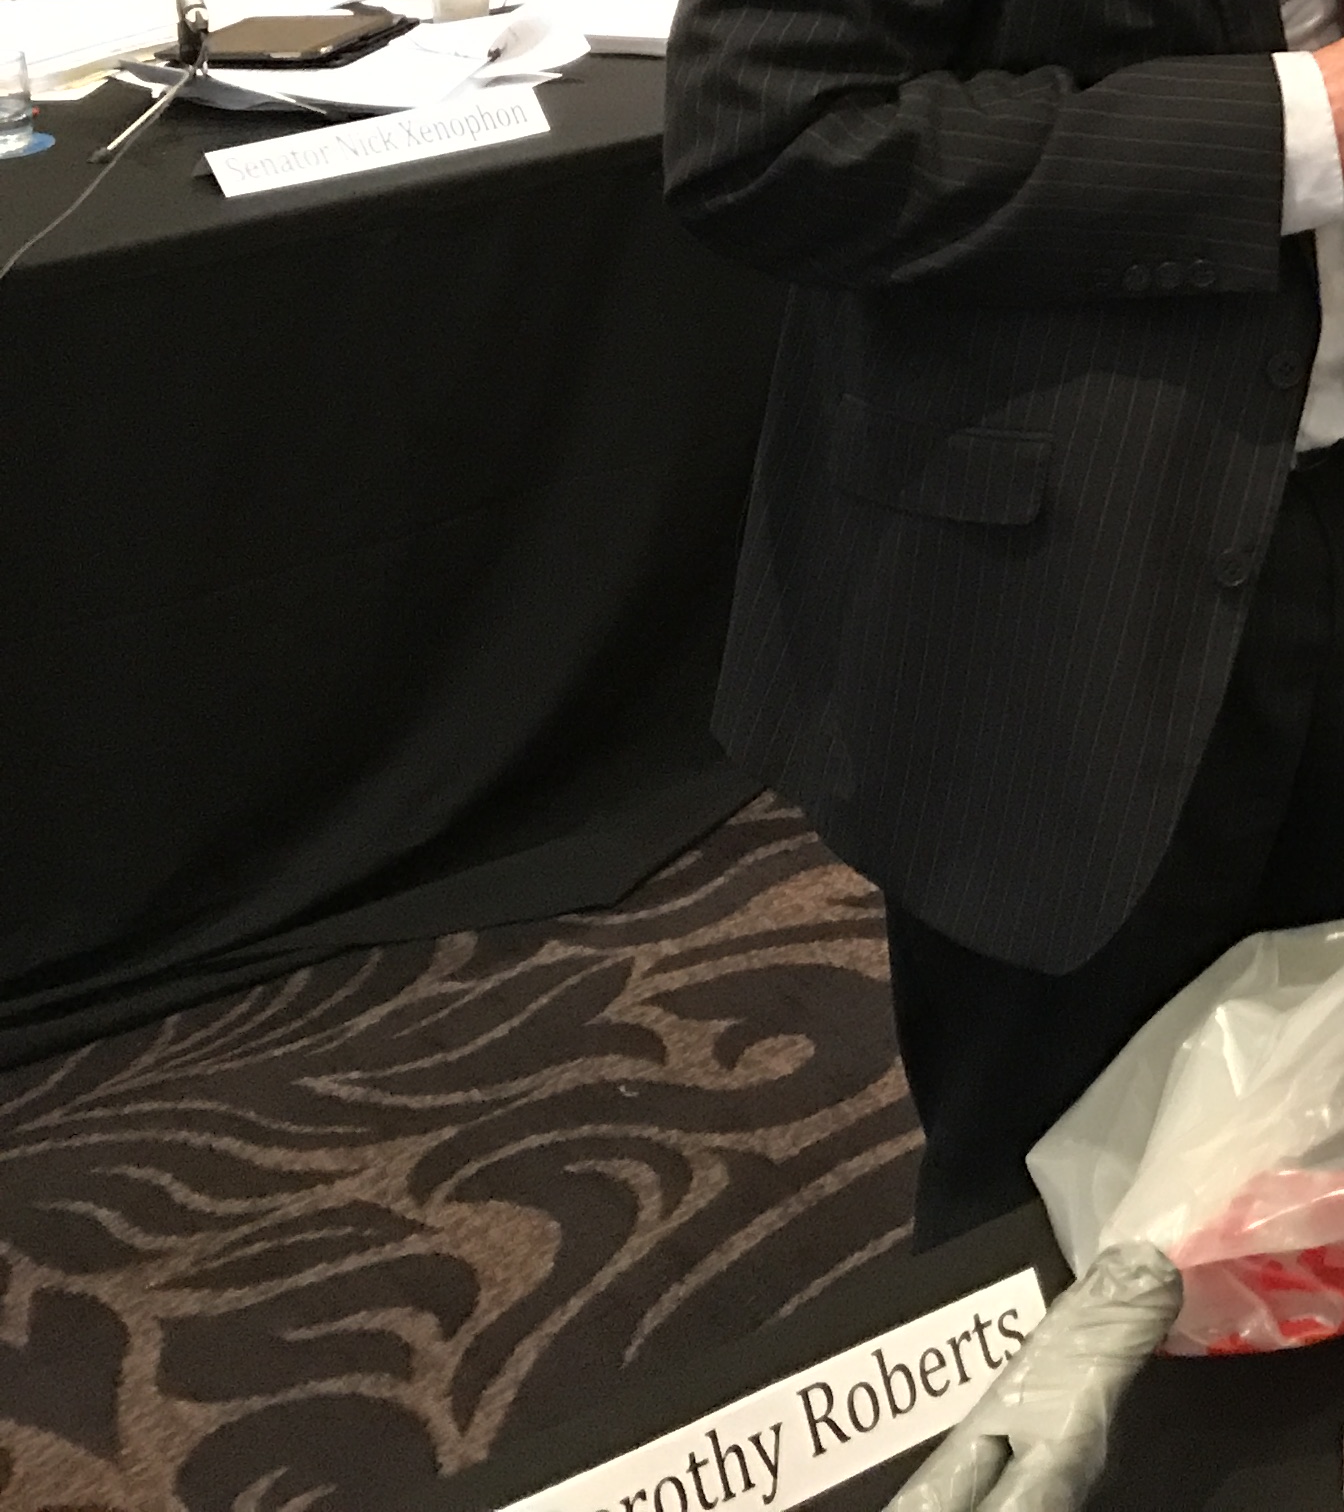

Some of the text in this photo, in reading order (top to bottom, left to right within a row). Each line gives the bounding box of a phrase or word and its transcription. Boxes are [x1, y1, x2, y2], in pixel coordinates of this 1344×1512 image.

[225, 104, 528, 182] Senator Nick Xenophon
[597, 1308, 1026, 1512] rothy Roberts
